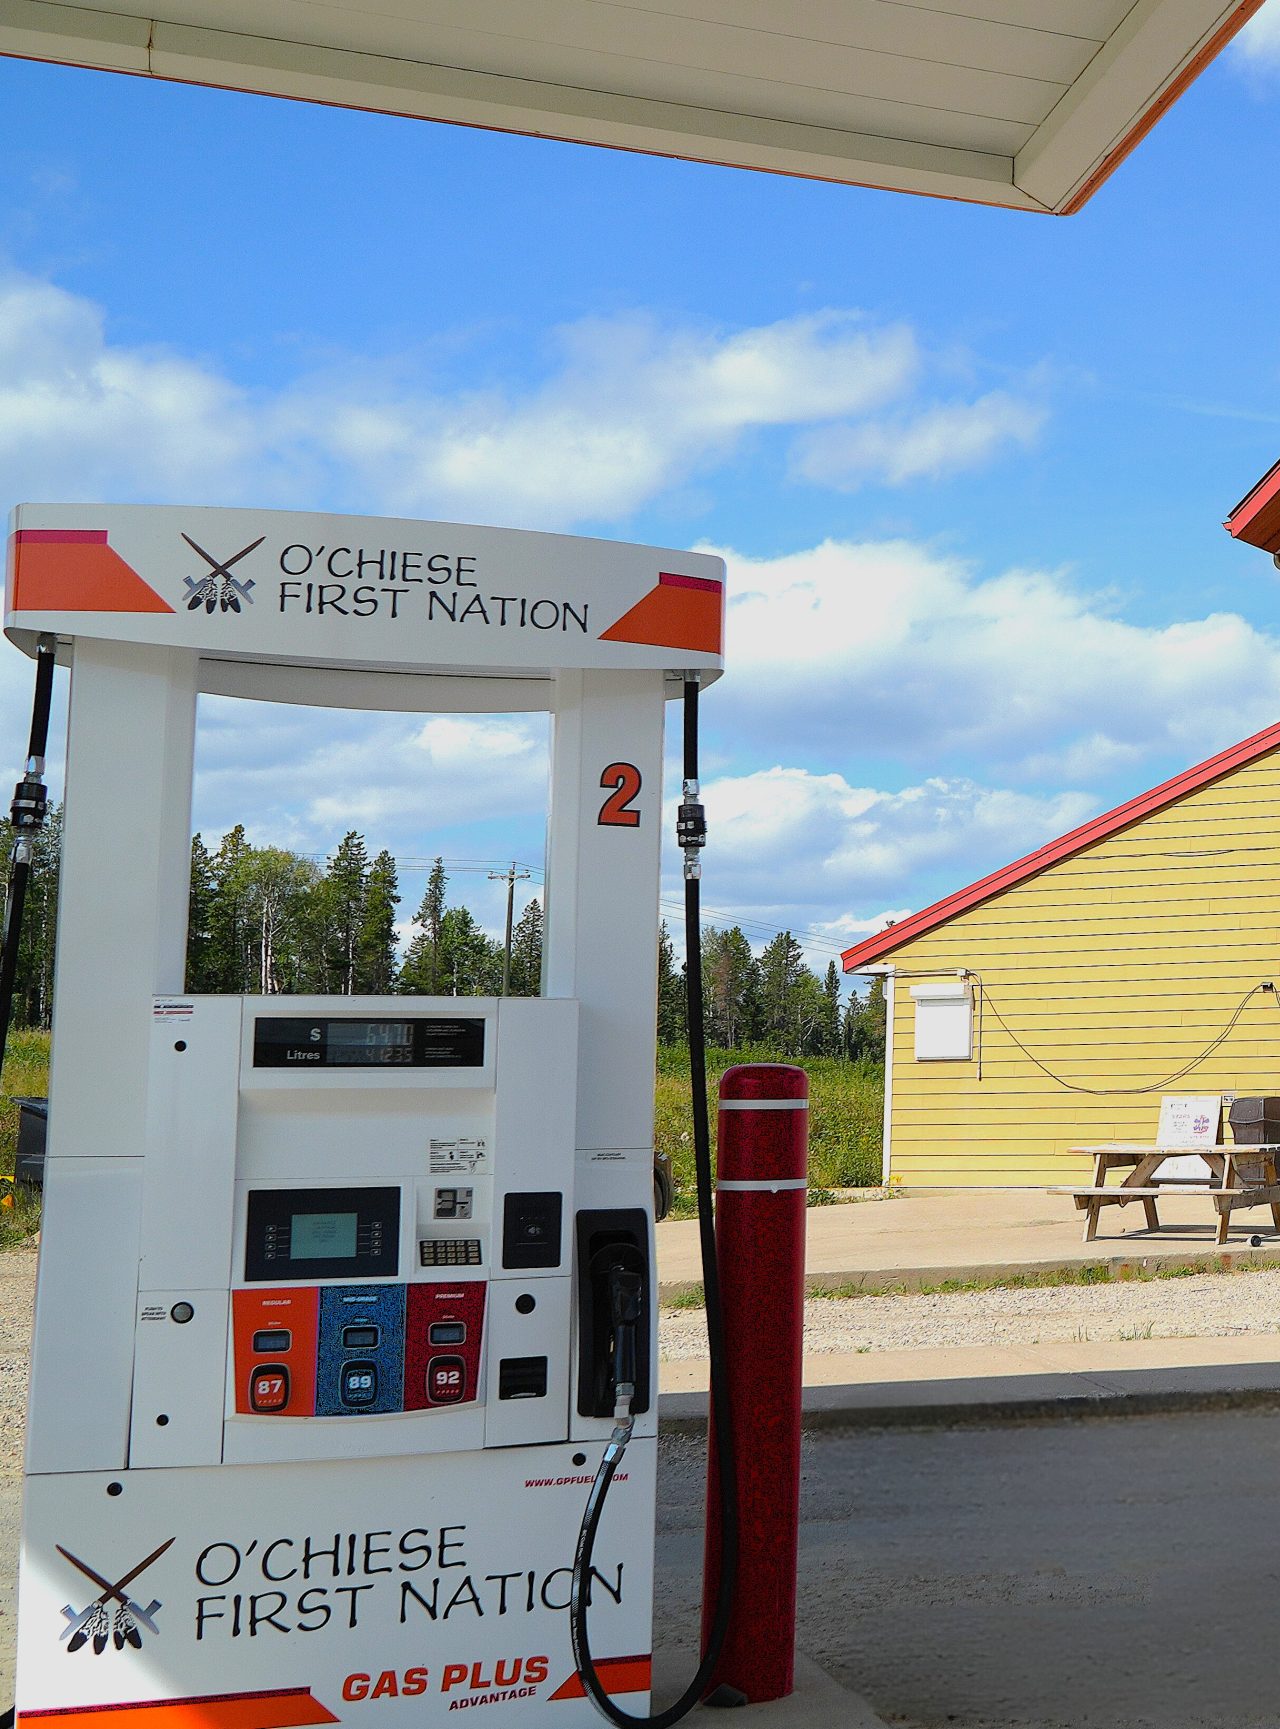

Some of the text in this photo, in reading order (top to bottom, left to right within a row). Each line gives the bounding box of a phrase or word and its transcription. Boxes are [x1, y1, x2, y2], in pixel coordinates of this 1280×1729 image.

[280, 544, 477, 587] O'CHIESE
[279, 582, 589, 633] FIRST NATION
[597, 762, 642, 827] 2
[286, 1050, 321, 1060] Litres
[258, 1380, 283, 1394] 87
[349, 1375, 372, 1389] 89
[436, 1371, 460, 1385] 92
[524, 1473, 629, 1488] WWW.GPFUELOM
[195, 1525, 467, 1587] O'CHIESE
[196, 1562, 624, 1641] FIRST NATION
[341, 1655, 550, 1702] GAS PLUS
[448, 1685, 537, 1711] ADVANTAGE
